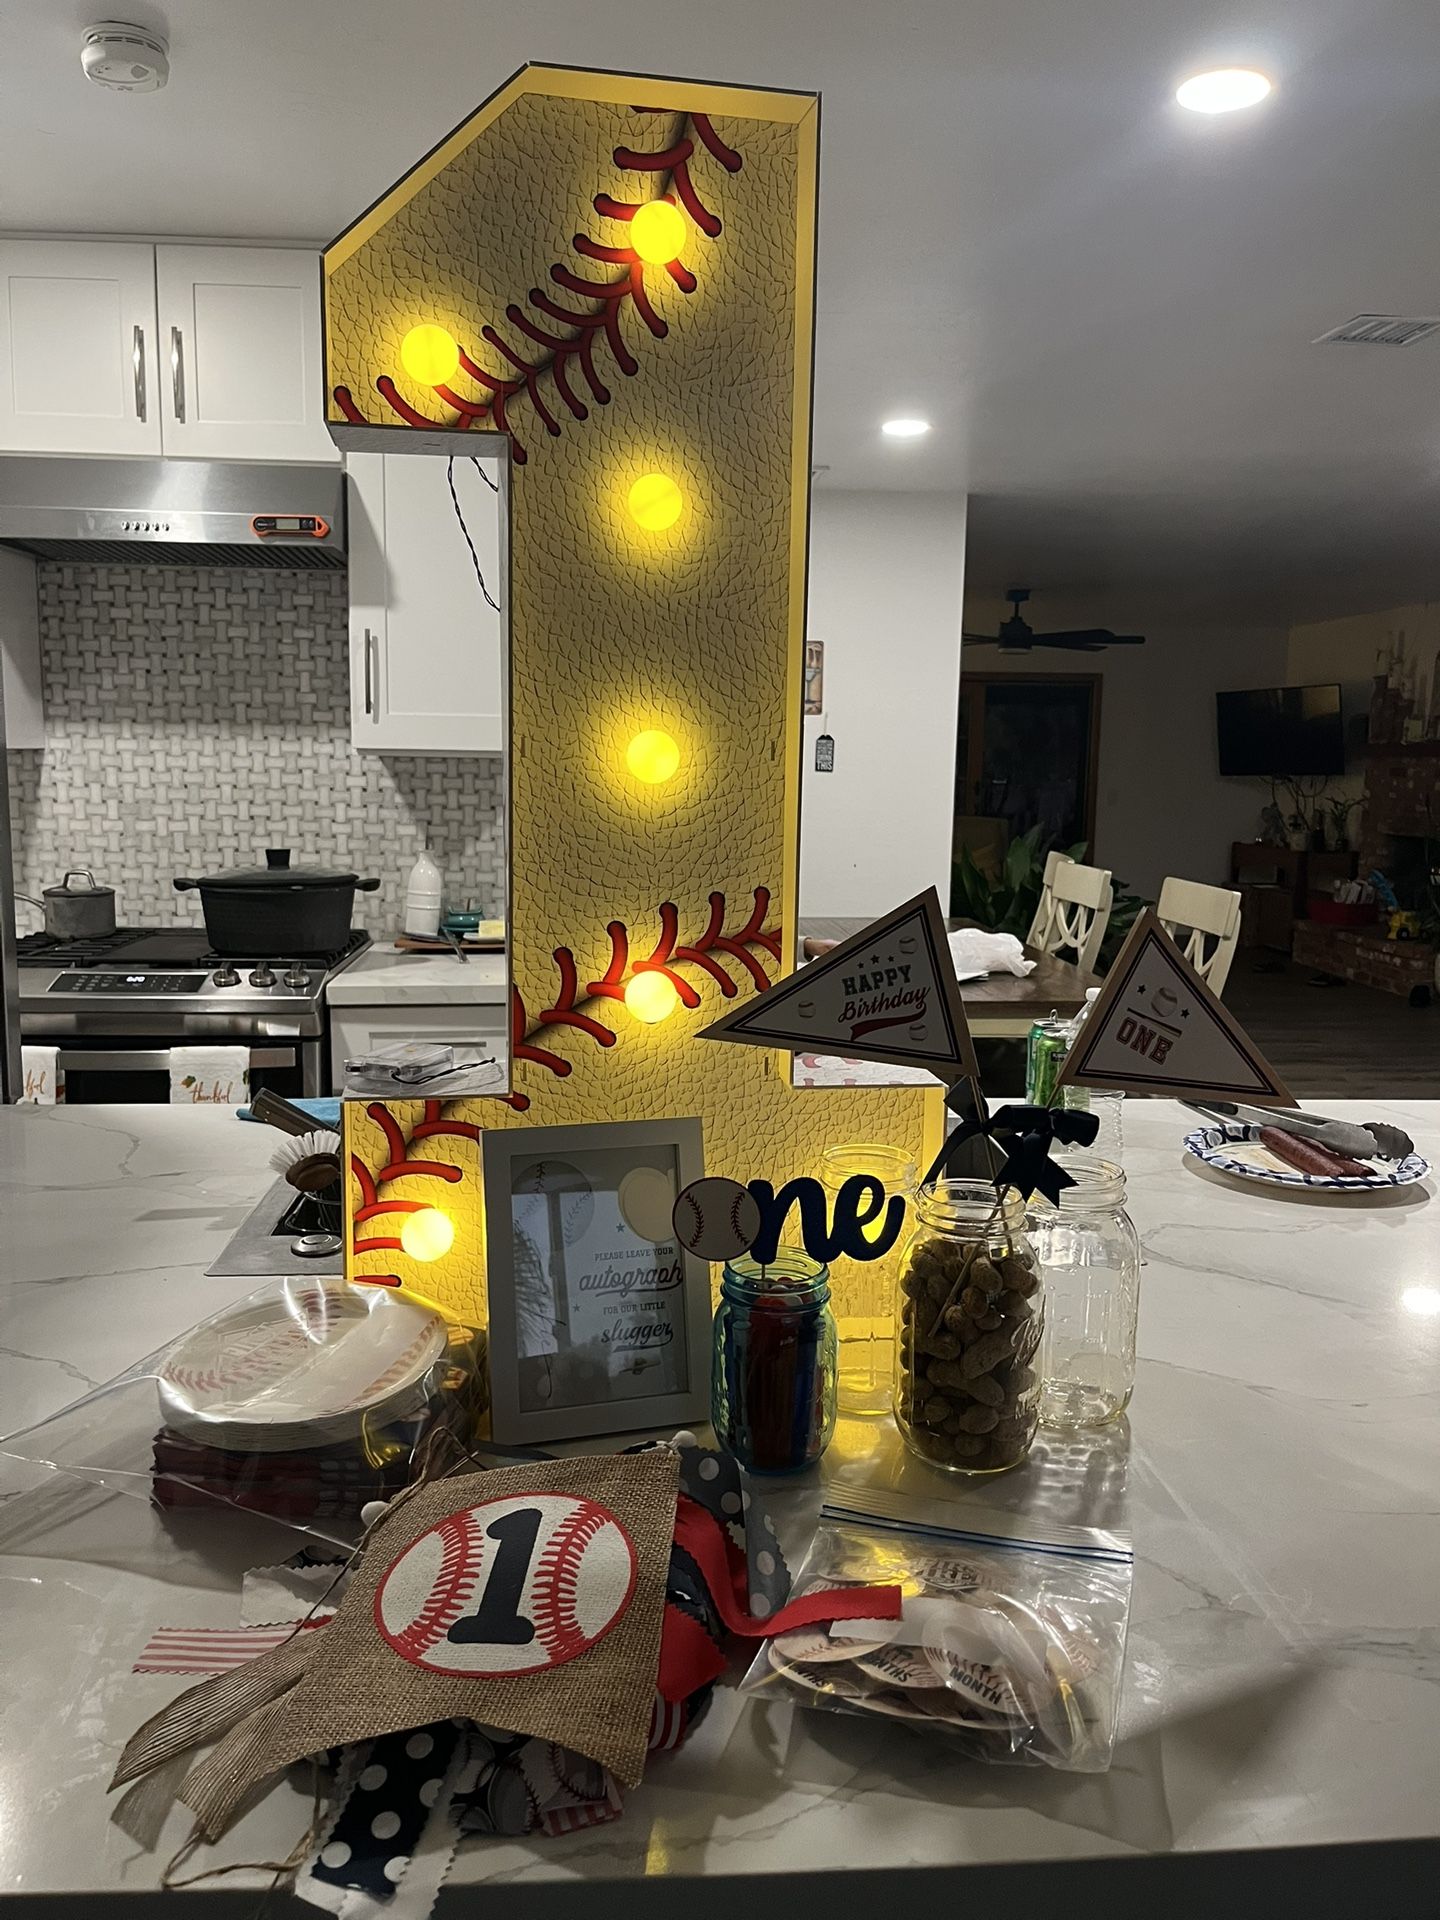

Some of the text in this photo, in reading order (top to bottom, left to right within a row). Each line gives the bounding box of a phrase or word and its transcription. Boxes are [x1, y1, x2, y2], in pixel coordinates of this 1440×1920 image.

[842, 964, 911, 996] HAPPY
[838, 987, 931, 1023] Birthday
[1116, 1016, 1174, 1065] ONE
[594, 1246, 674, 1261] PLEASE LEAVE YOUR
[579, 1259, 683, 1298] autograph
[603, 1301, 666, 1315] FOR OUR LITTLE
[601, 1318, 673, 1346] slugger
[446, 1508, 543, 1645] 1
[949, 1665, 1004, 1705] MONTH
